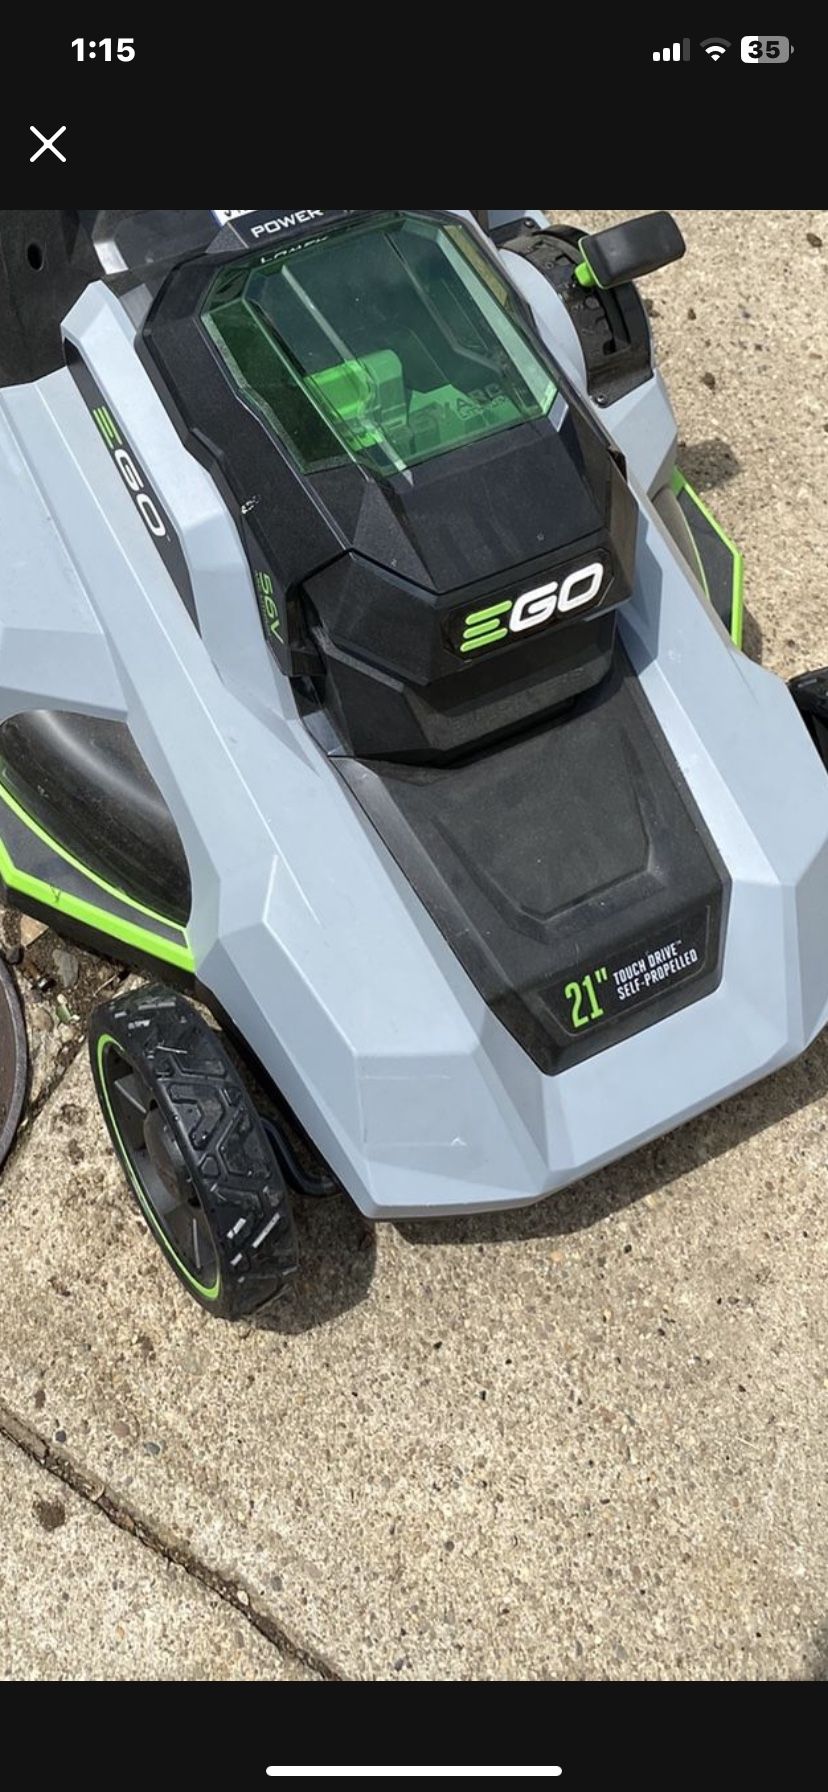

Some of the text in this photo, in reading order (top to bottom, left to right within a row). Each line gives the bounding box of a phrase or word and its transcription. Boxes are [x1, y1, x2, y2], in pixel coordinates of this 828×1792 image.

[251, 210, 324, 239] POWER
[93, 406, 166, 537] EGO
[259, 571, 284, 644] 56V
[460, 562, 604, 652] EGO
[565, 966, 608, 1028] 21"
[613, 959, 646, 986] TOUCH
[617, 948, 698, 1000] SELF-PROPELLED
